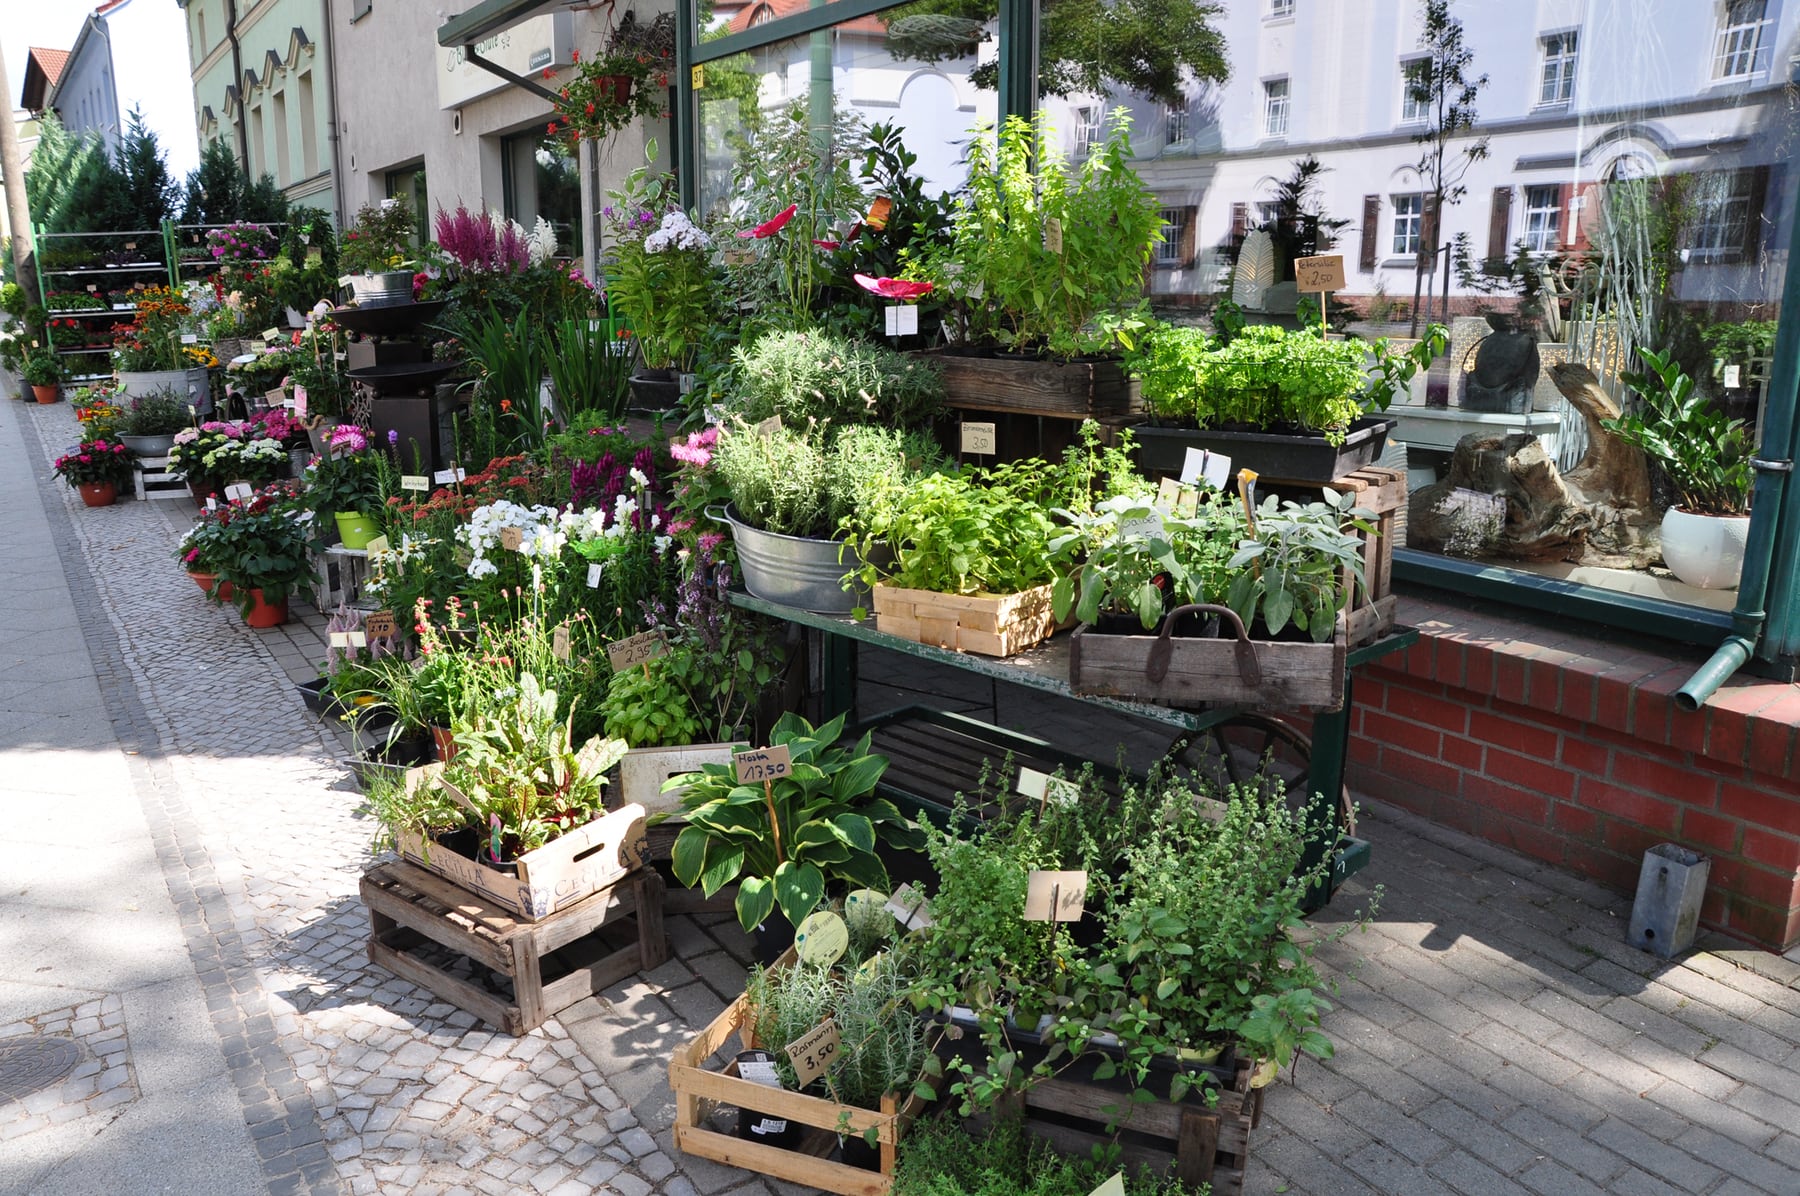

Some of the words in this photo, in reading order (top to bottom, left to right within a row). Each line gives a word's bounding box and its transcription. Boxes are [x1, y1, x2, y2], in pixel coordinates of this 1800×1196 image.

[1311, 270, 1333, 286] 2,50
[626, 644, 652, 664] 2,95
[738, 752, 769, 763] Hosta
[744, 763, 786, 780] 17,50
[789, 1025, 833, 1058] Rosmarin
[804, 1042, 834, 1070] 3,50
